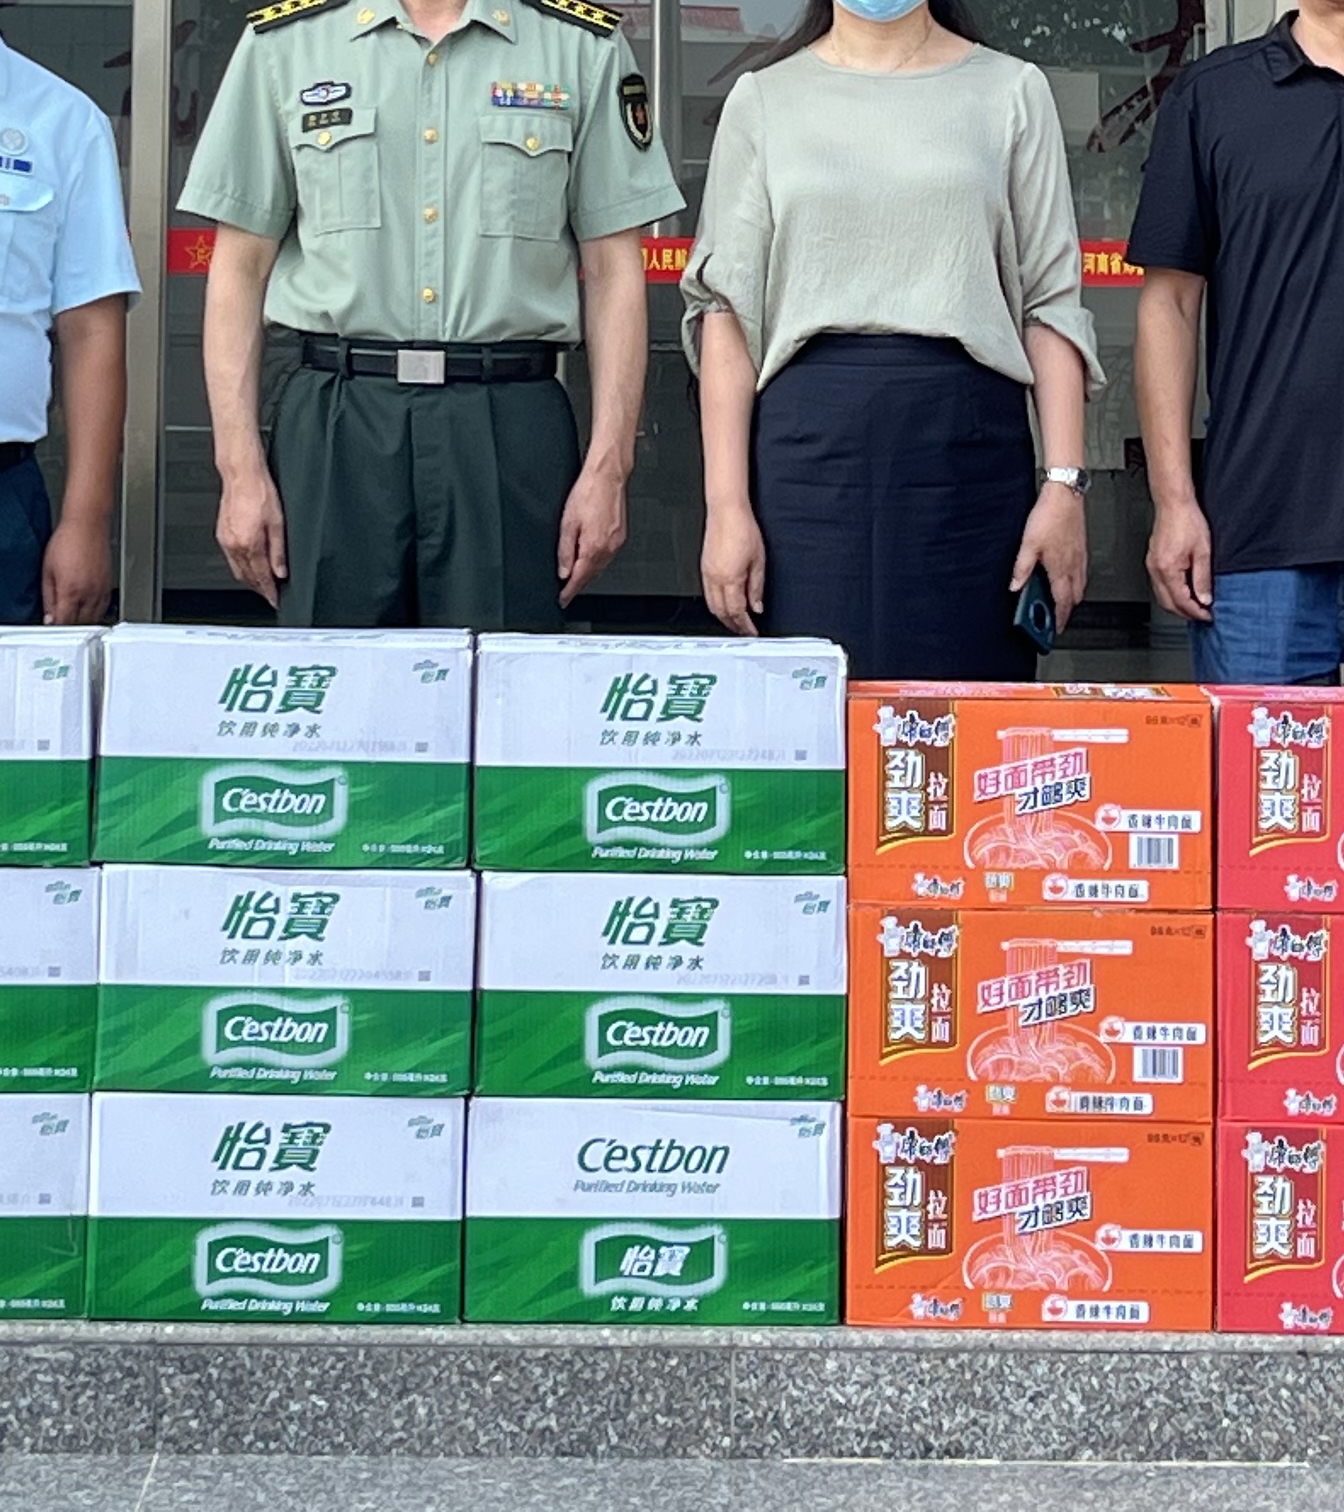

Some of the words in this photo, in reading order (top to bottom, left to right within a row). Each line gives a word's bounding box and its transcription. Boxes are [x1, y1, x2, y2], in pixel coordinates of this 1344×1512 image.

[219, 665, 336, 713] 怡寶
[601, 674, 716, 721] 怡寶
[885, 749, 925, 830] 劲爽
[927, 773, 949, 831] 拉面
[977, 752, 1086, 795] 好面带劲
[1017, 779, 1090, 810] 才够爽
[1258, 750, 1298, 831] 劲爽
[1301, 775, 1322, 832] 拉面
[222, 892, 340, 940] 怡寶
[602, 897, 720, 945] 怡寶
[888, 959, 929, 1042] 劲爽
[981, 963, 1090, 1006] 好面带劲
[1021, 990, 1094, 1021] 才够爽
[1257, 964, 1297, 1045] 劲爽
[930, 984, 953, 1043] 拉面
[1300, 989, 1321, 1046] 拉面
[212, 1122, 332, 1171] 怡寶
[884, 1166, 925, 1249] 劲爽
[978, 1170, 1087, 1213] 好面带劲
[1018, 1198, 1091, 1229] 才够爽
[1253, 1175, 1294, 1258] 劲爽
[927, 1192, 948, 1249] 拉面
[1296, 1200, 1318, 1258] 拉面
